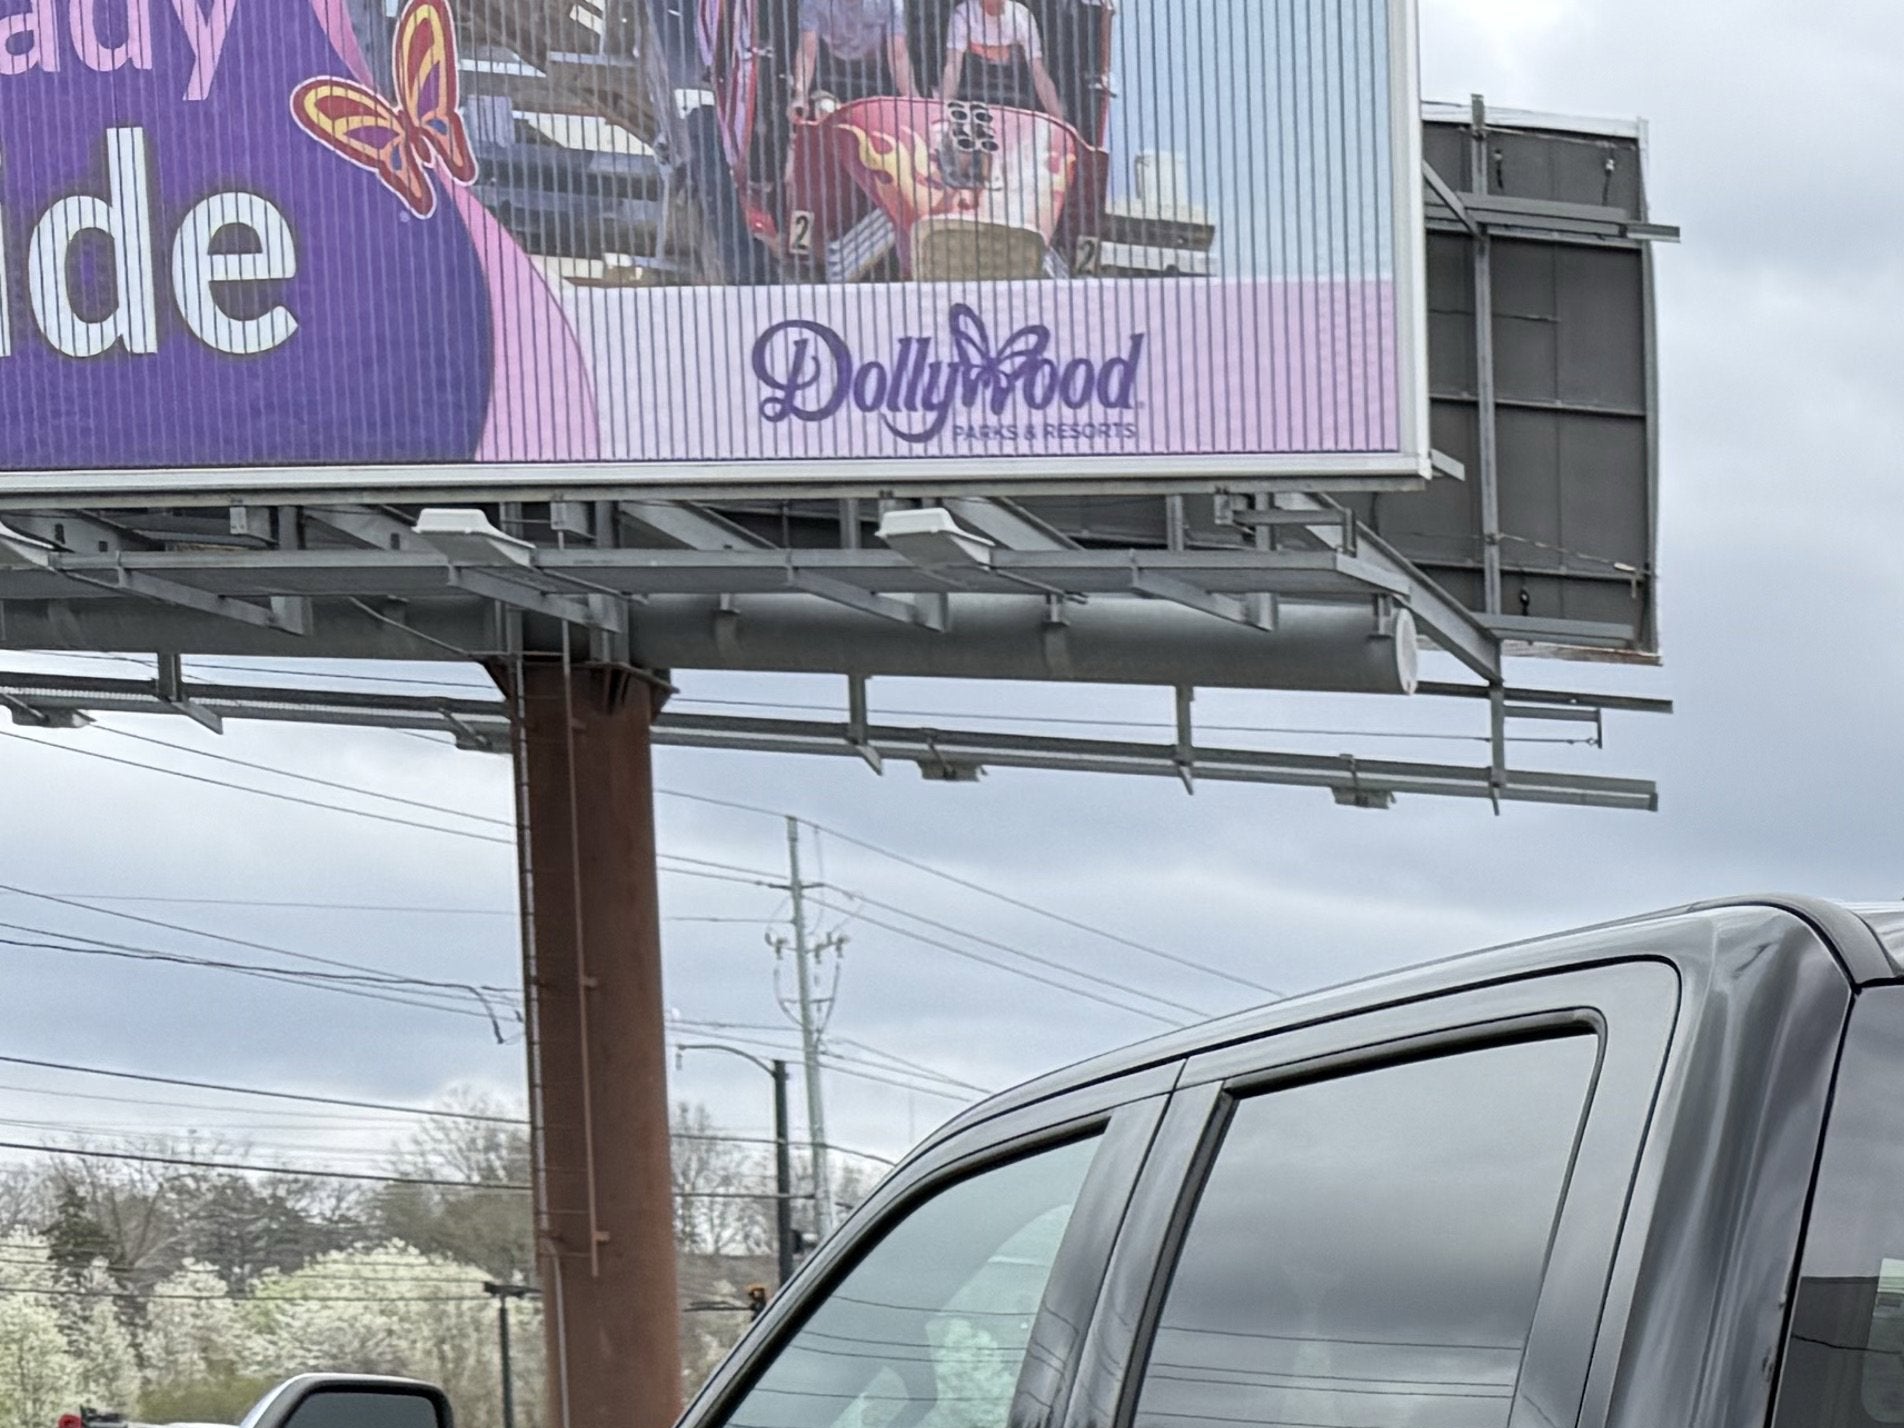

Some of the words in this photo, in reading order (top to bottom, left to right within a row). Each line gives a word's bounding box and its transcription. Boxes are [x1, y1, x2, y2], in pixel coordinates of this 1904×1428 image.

[0, 127, 299, 358] de
[955, 423, 1017, 441] PARKS
[1024, 424, 1036, 441] &
[1043, 422, 1137, 440] RESORTS
